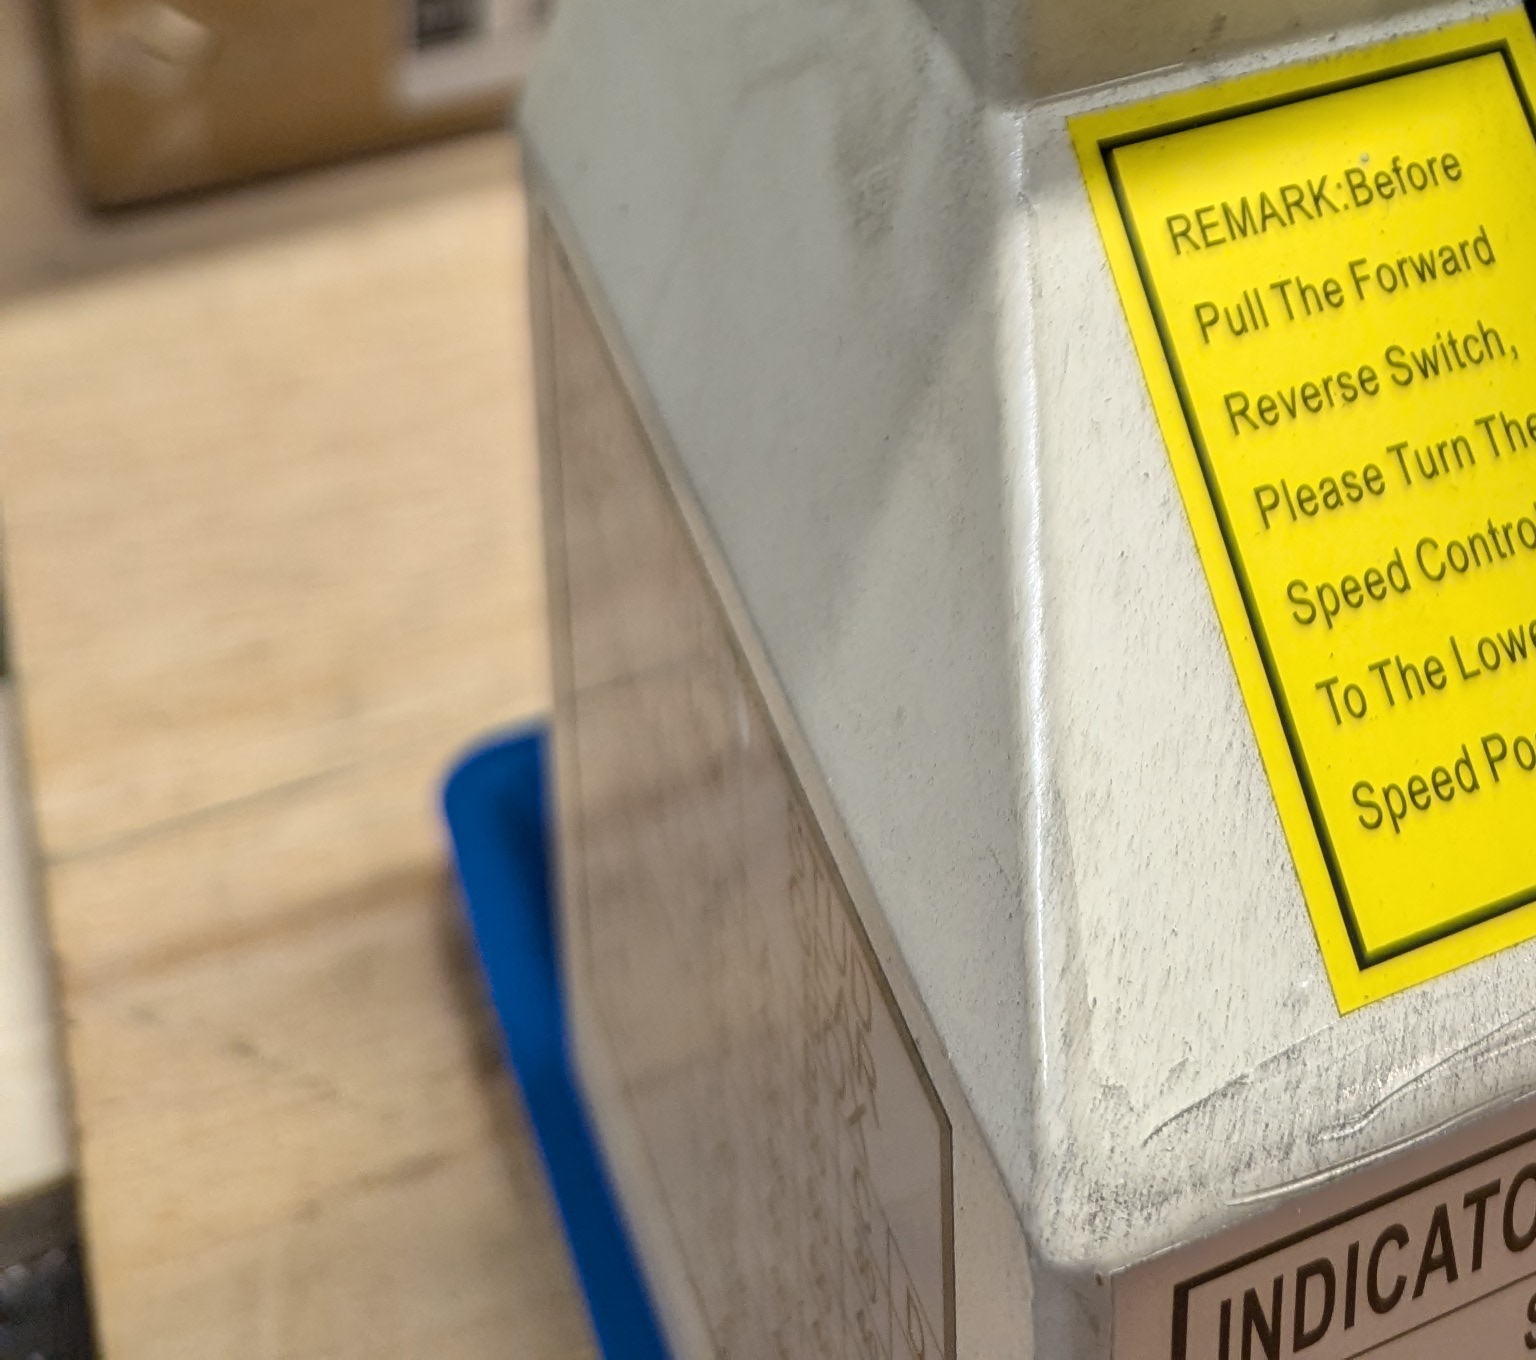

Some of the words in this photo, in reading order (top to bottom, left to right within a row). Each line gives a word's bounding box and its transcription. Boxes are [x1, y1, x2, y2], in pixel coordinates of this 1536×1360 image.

[1165, 150, 1463, 256] REMARK:Before
[1193, 287, 1269, 345] Pull
[1270, 270, 1345, 322] The
[1350, 224, 1497, 302] Forward
[1223, 365, 1380, 437] Reverse
[1384, 319, 1519, 391] Switch,
[1253, 460, 1385, 531] Please
[1385, 433, 1476, 490] Turn
[1286, 548, 1412, 631] Speed
[1314, 674, 1368, 728] To
[1368, 650, 1448, 708] The
[1351, 744, 1481, 836] Speed
